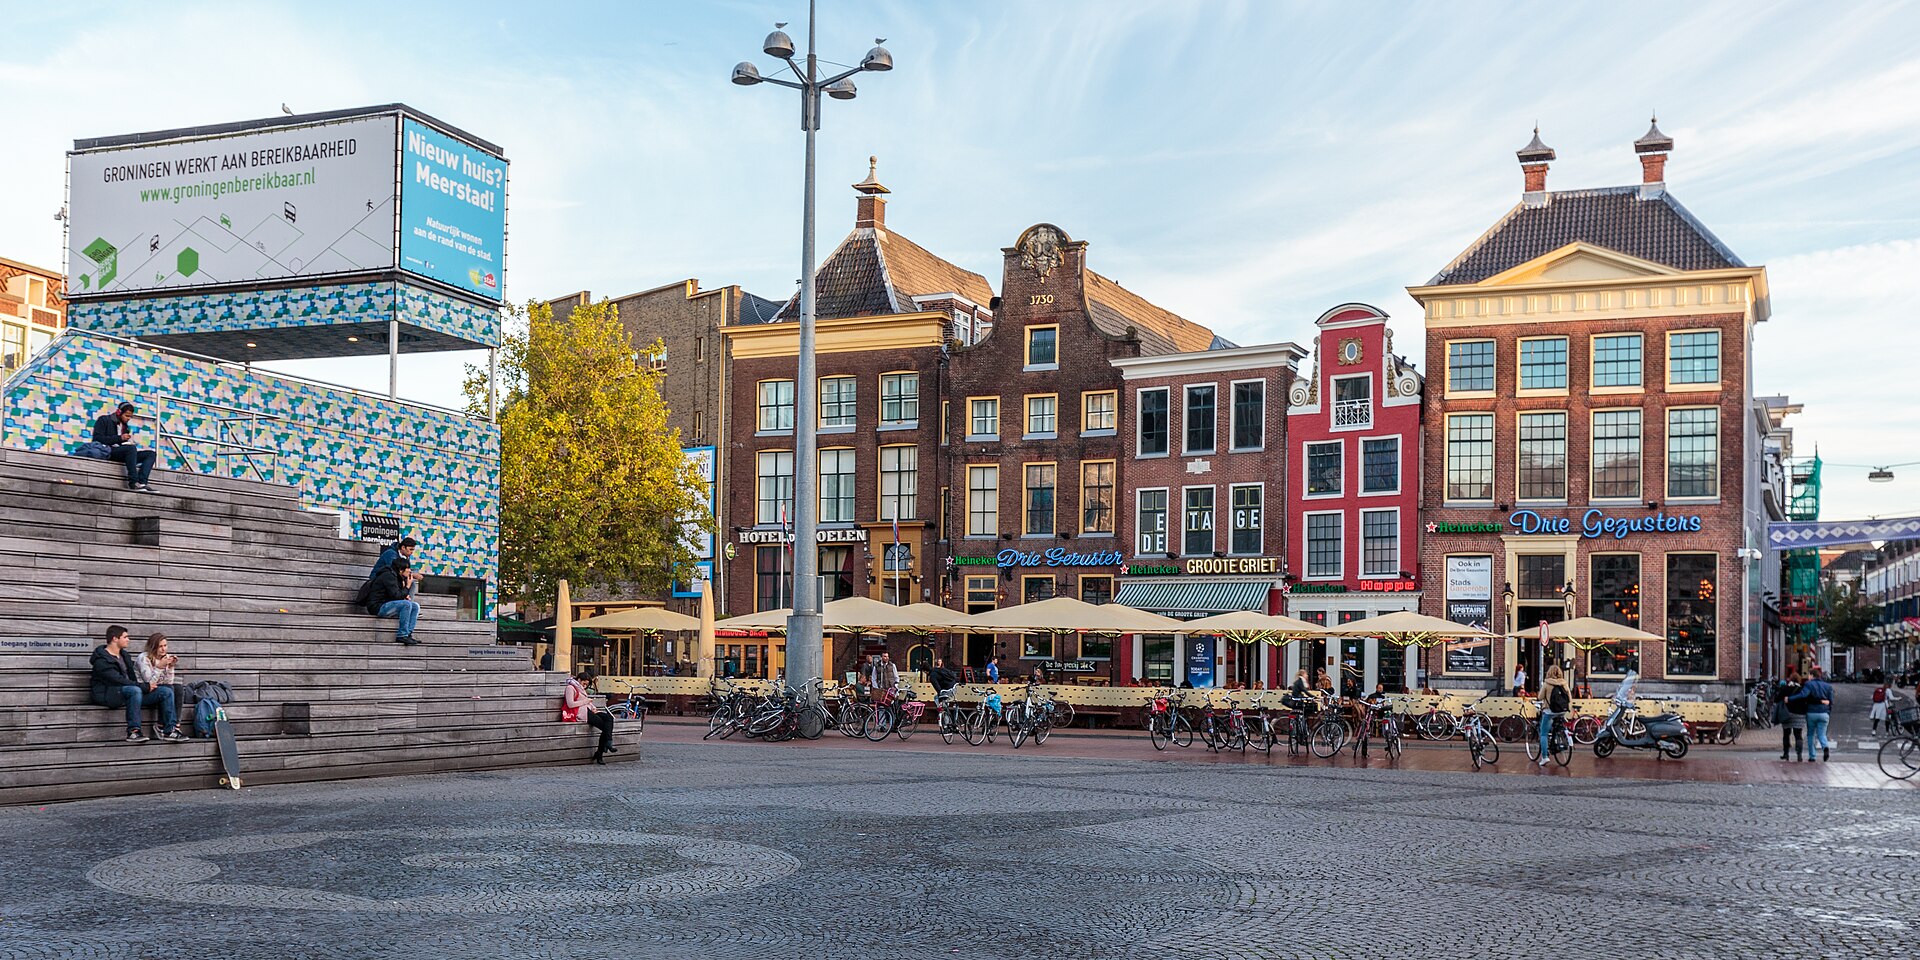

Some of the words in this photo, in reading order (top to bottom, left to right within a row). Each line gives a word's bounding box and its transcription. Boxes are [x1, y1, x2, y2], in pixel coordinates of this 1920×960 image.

[103, 161, 171, 183] GRONINGEN
[174, 155, 218, 175] WERKT
[221, 152, 247, 171] AAN
[251, 138, 357, 167] BEREIKBAARHEID
[408, 130, 460, 171] Nieuw
[462, 153, 503, 189] huis?
[140, 167, 316, 204] www.groningenbereikbaar.nl
[416, 161, 495, 212] Meerstad!
[426, 216, 460, 238] Natuurlijk
[460, 230, 483, 246] wonen
[413, 226, 427, 236] aan
[427, 230, 437, 242] de
[437, 235, 454, 248] rand
[454, 241, 467, 252] van
[467, 245, 476, 256] de
[477, 249, 493, 262] stad.
[1030, 294, 1054, 305] 1730
[363, 525, 398, 537] groningen
[1439, 521, 1502, 533] Heineken
[1509, 510, 1570, 534] Drie
[1583, 509, 1701, 539] Gezusters
[740, 531, 787, 543] HOTEL
[816, 529, 867, 542] OELEN
[1143, 534, 1165, 552] DE
[955, 555, 998, 565] Heineken
[996, 549, 1041, 567] Drie
[1044, 547, 1123, 567] Gezuster
[1130, 564, 1179, 574] Heineken
[1186, 558, 1237, 574] GROOTE
[1239, 557, 1277, 573] GRIET
[1293, 583, 1346, 593] Heineken
[1360, 580, 1415, 592] Hoppe
[1450, 604, 1487, 614] UPSTAIRS
[1, 640, 28, 648] toegang
